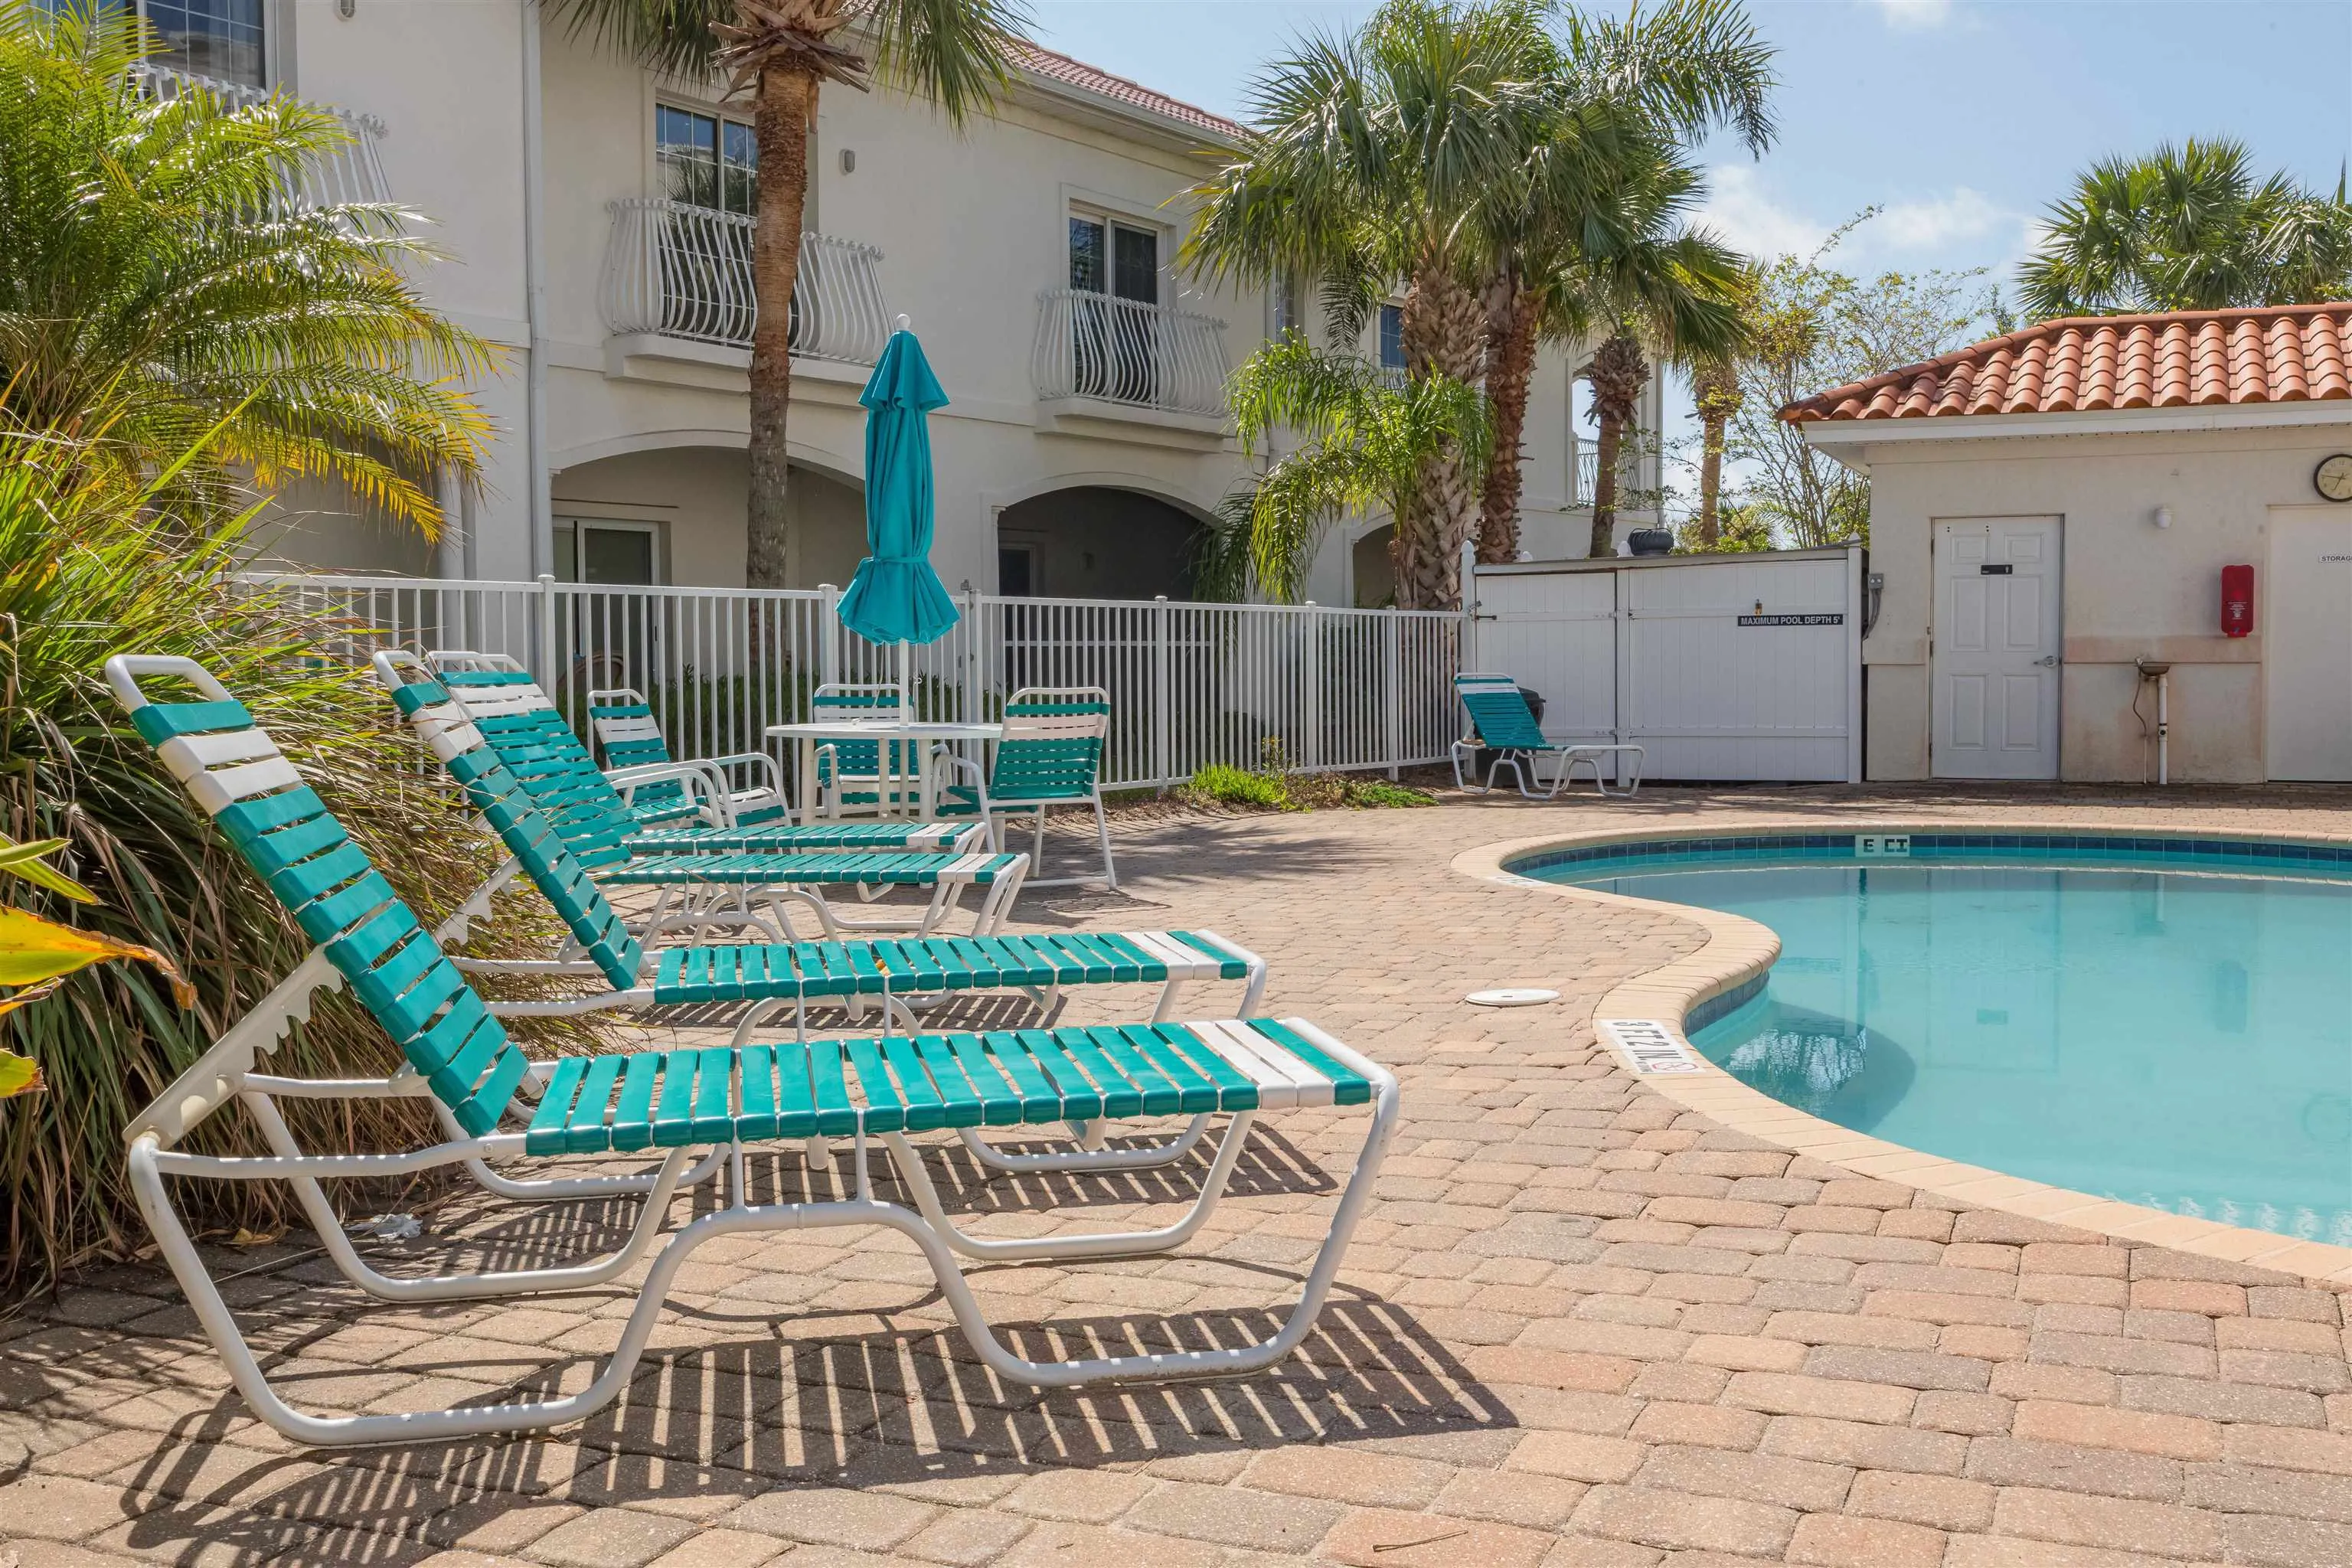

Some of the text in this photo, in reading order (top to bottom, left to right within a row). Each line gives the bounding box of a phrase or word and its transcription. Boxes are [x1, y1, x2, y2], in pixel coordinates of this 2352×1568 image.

[1740, 616, 1841, 626] MAXIMUM POOL DEPTH 5'
